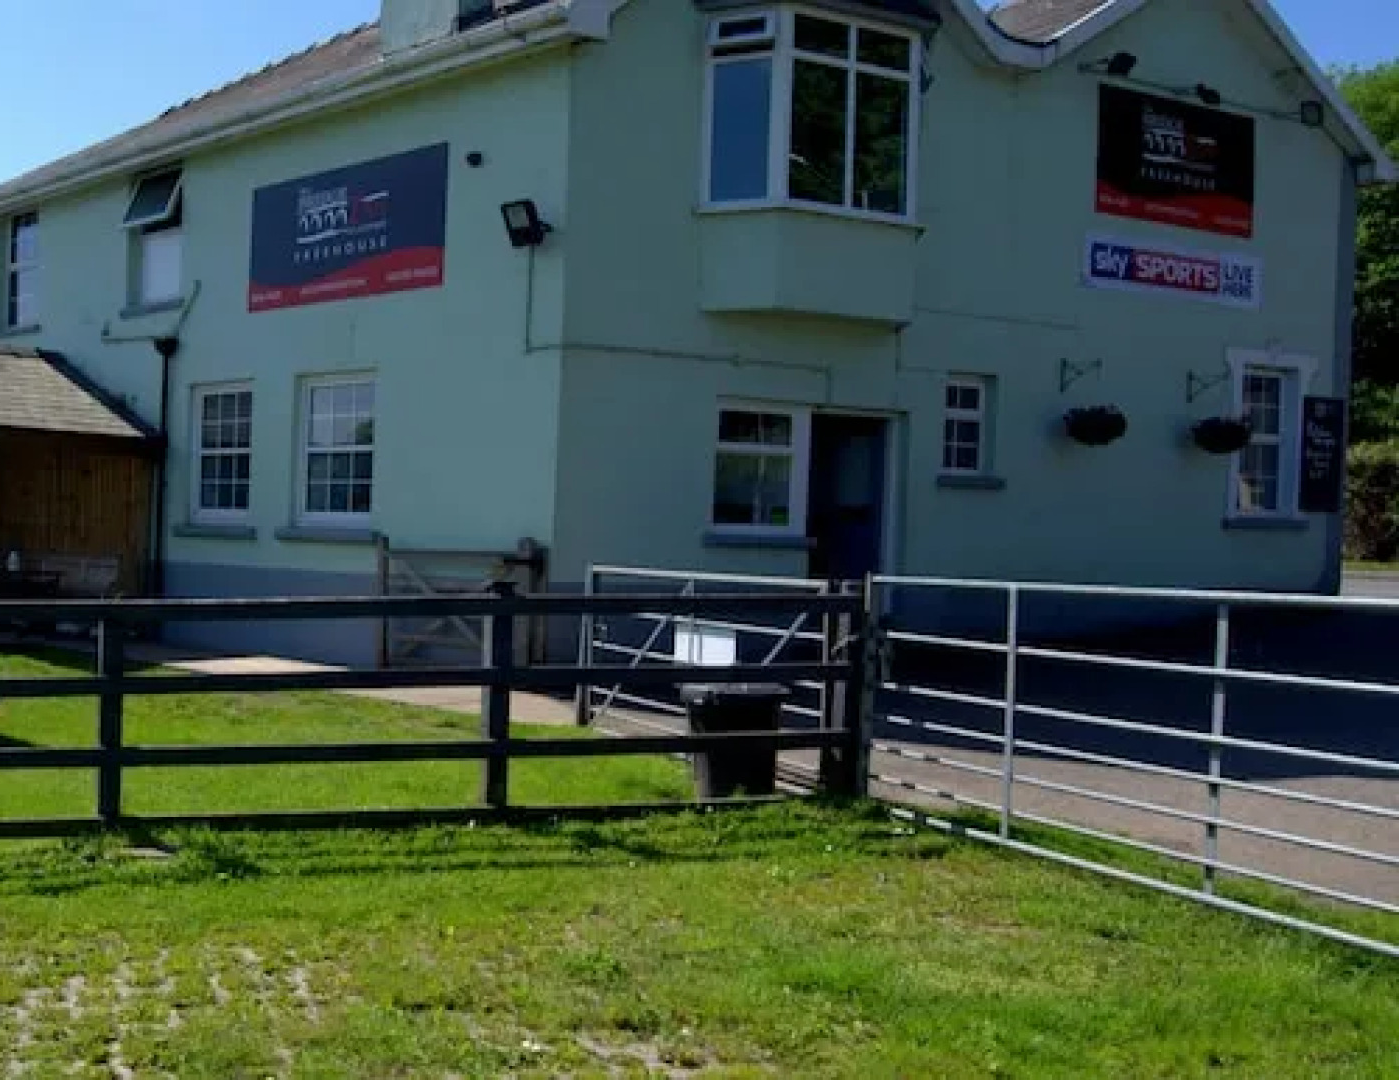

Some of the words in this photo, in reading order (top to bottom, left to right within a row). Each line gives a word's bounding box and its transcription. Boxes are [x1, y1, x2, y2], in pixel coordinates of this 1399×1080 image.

[1096, 246, 1129, 278] sky
[1135, 254, 1218, 289] SPORTS
[1222, 261, 1254, 283] LIVE
